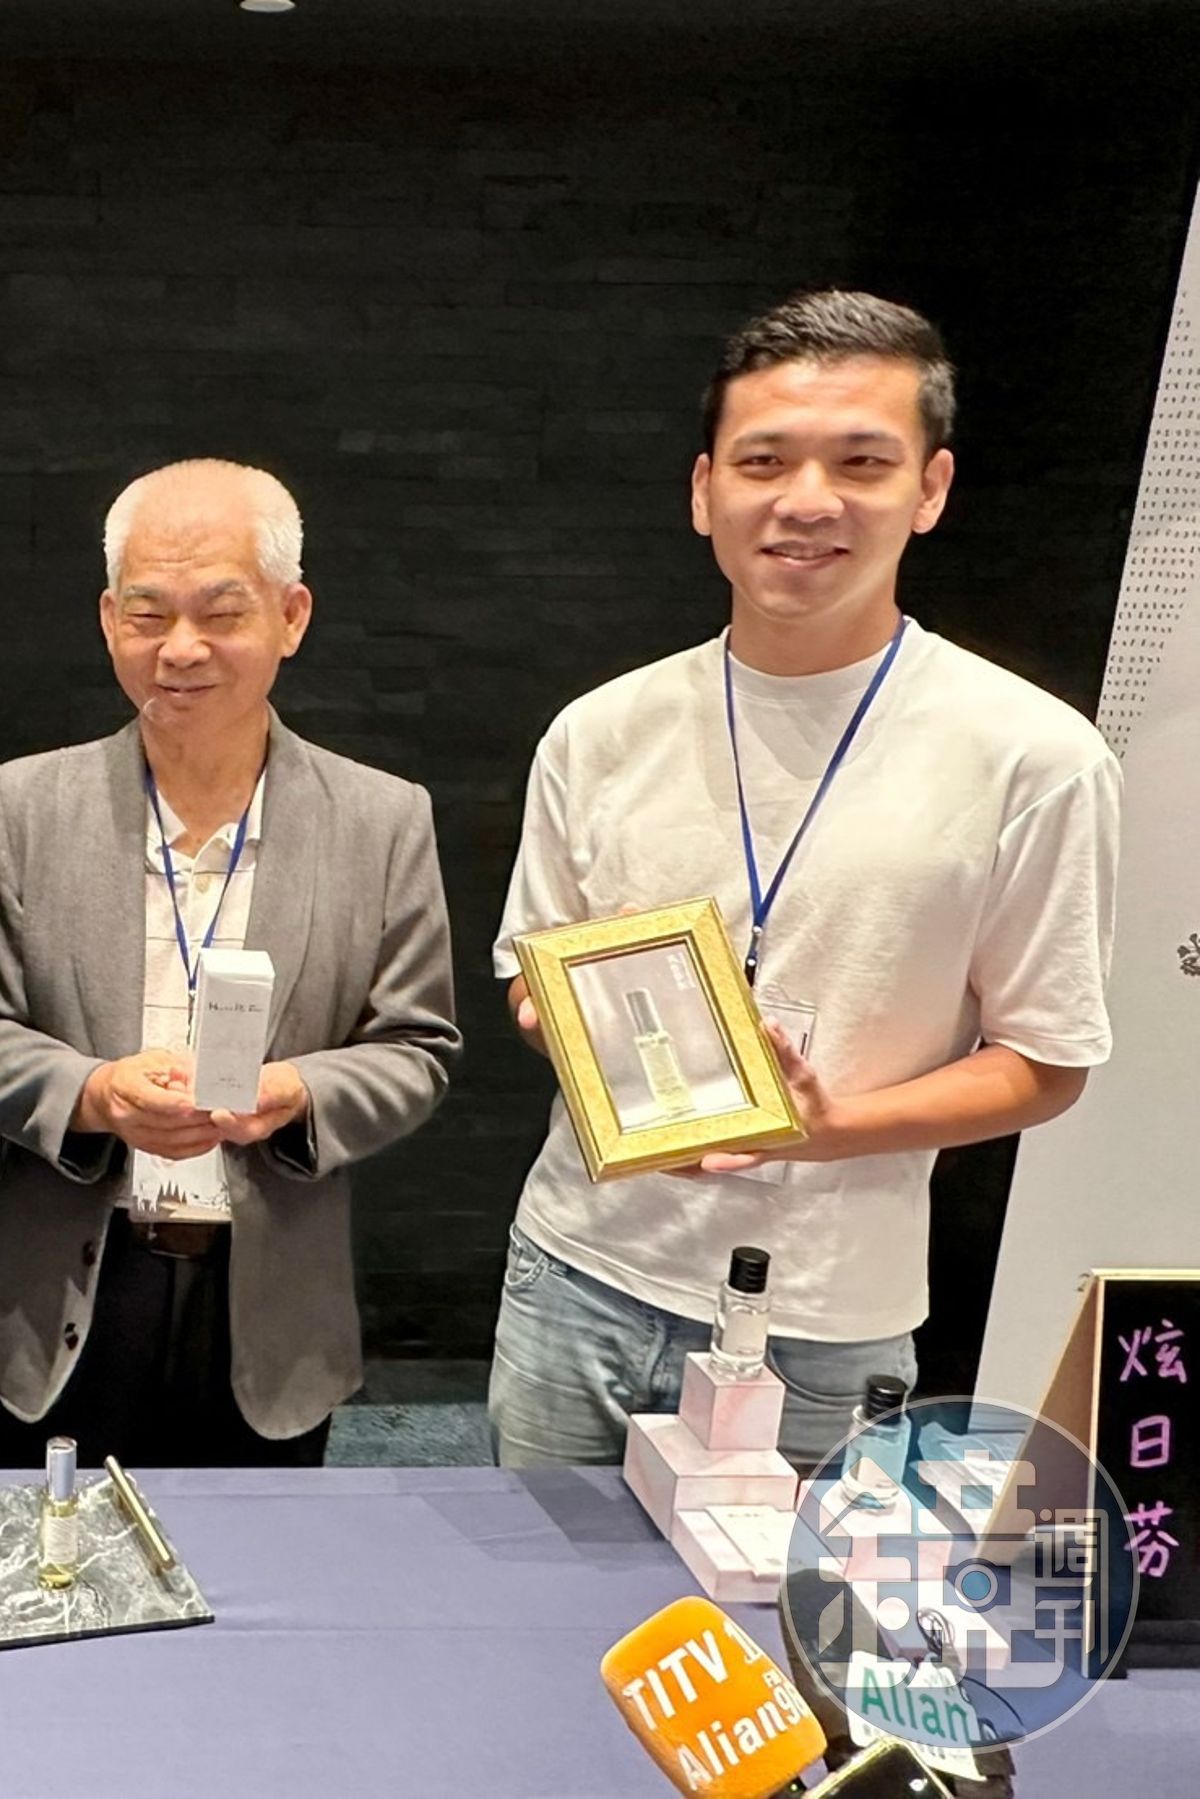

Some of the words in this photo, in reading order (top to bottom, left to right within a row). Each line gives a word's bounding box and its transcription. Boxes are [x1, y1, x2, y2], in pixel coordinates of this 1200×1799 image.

[1118, 1318, 1188, 1578] 炫日芬
[622, 1629, 728, 1731] TITV
[861, 1667, 972, 1743] Alian
